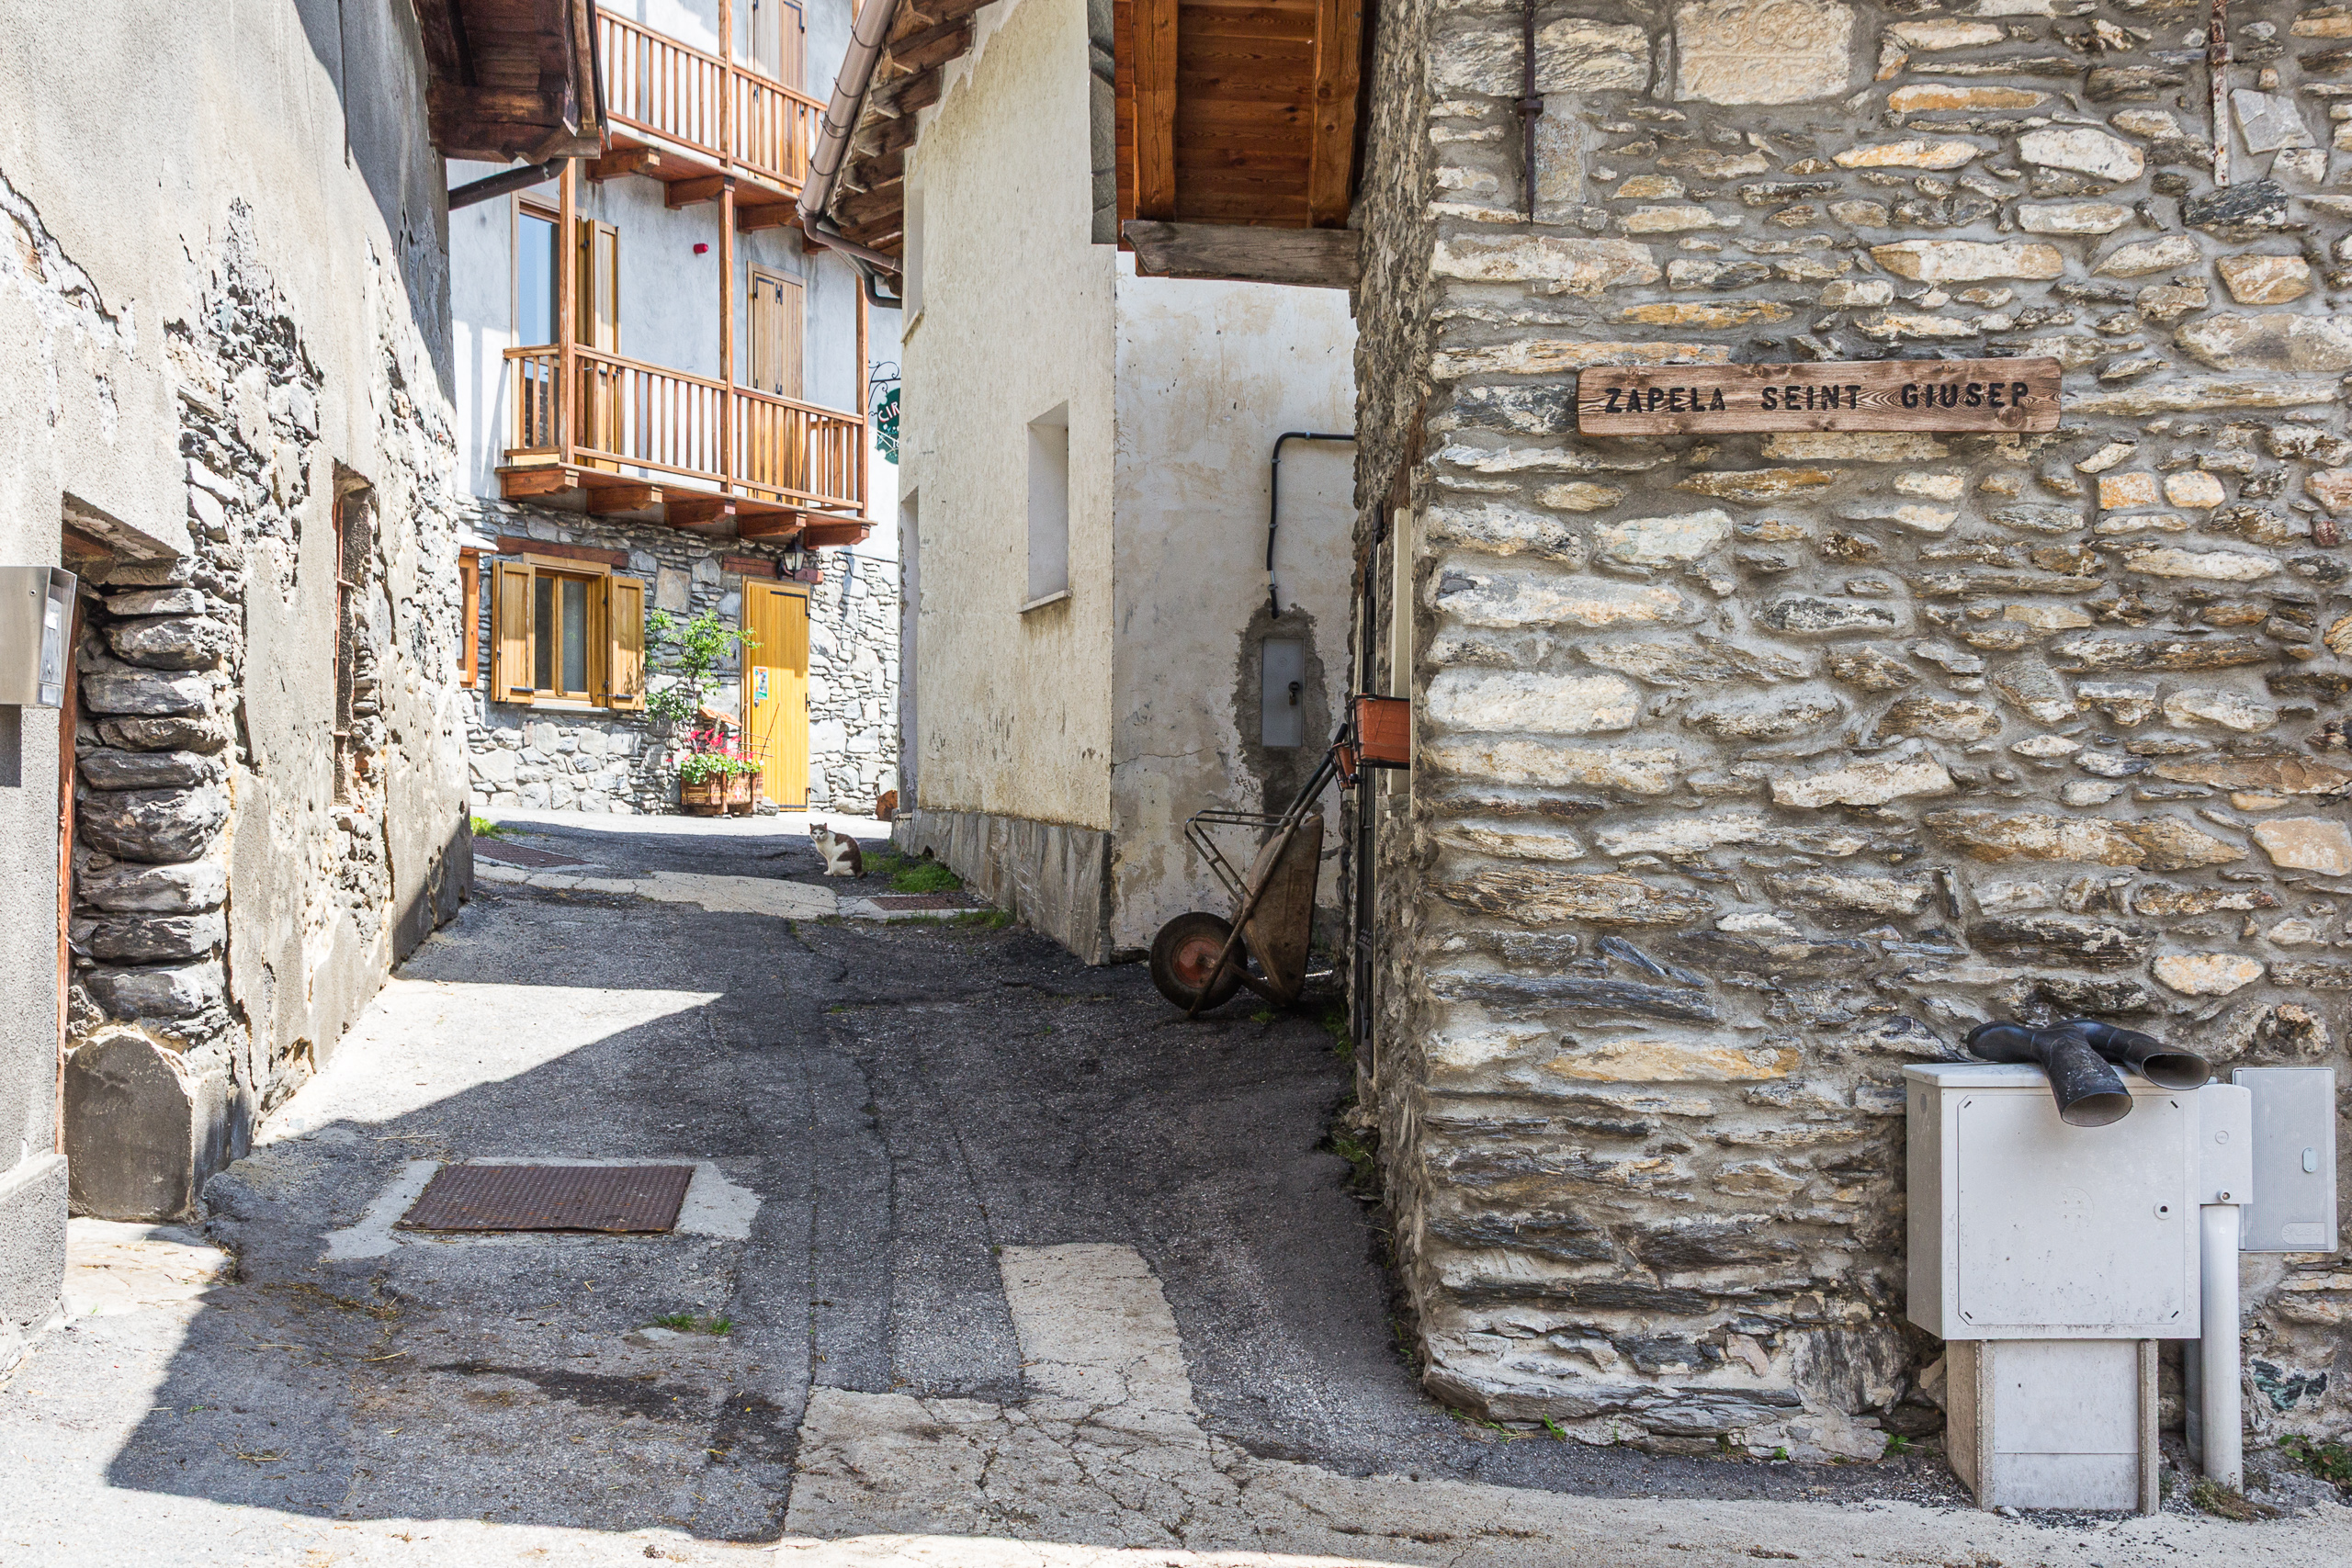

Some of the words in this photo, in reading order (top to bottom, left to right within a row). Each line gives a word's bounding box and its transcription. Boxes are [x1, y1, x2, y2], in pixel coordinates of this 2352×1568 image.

[1604, 387, 1726, 414] ZAPELA
[1760, 385, 1862, 412] SEINT
[1901, 381, 2030, 410] GIUSEP
